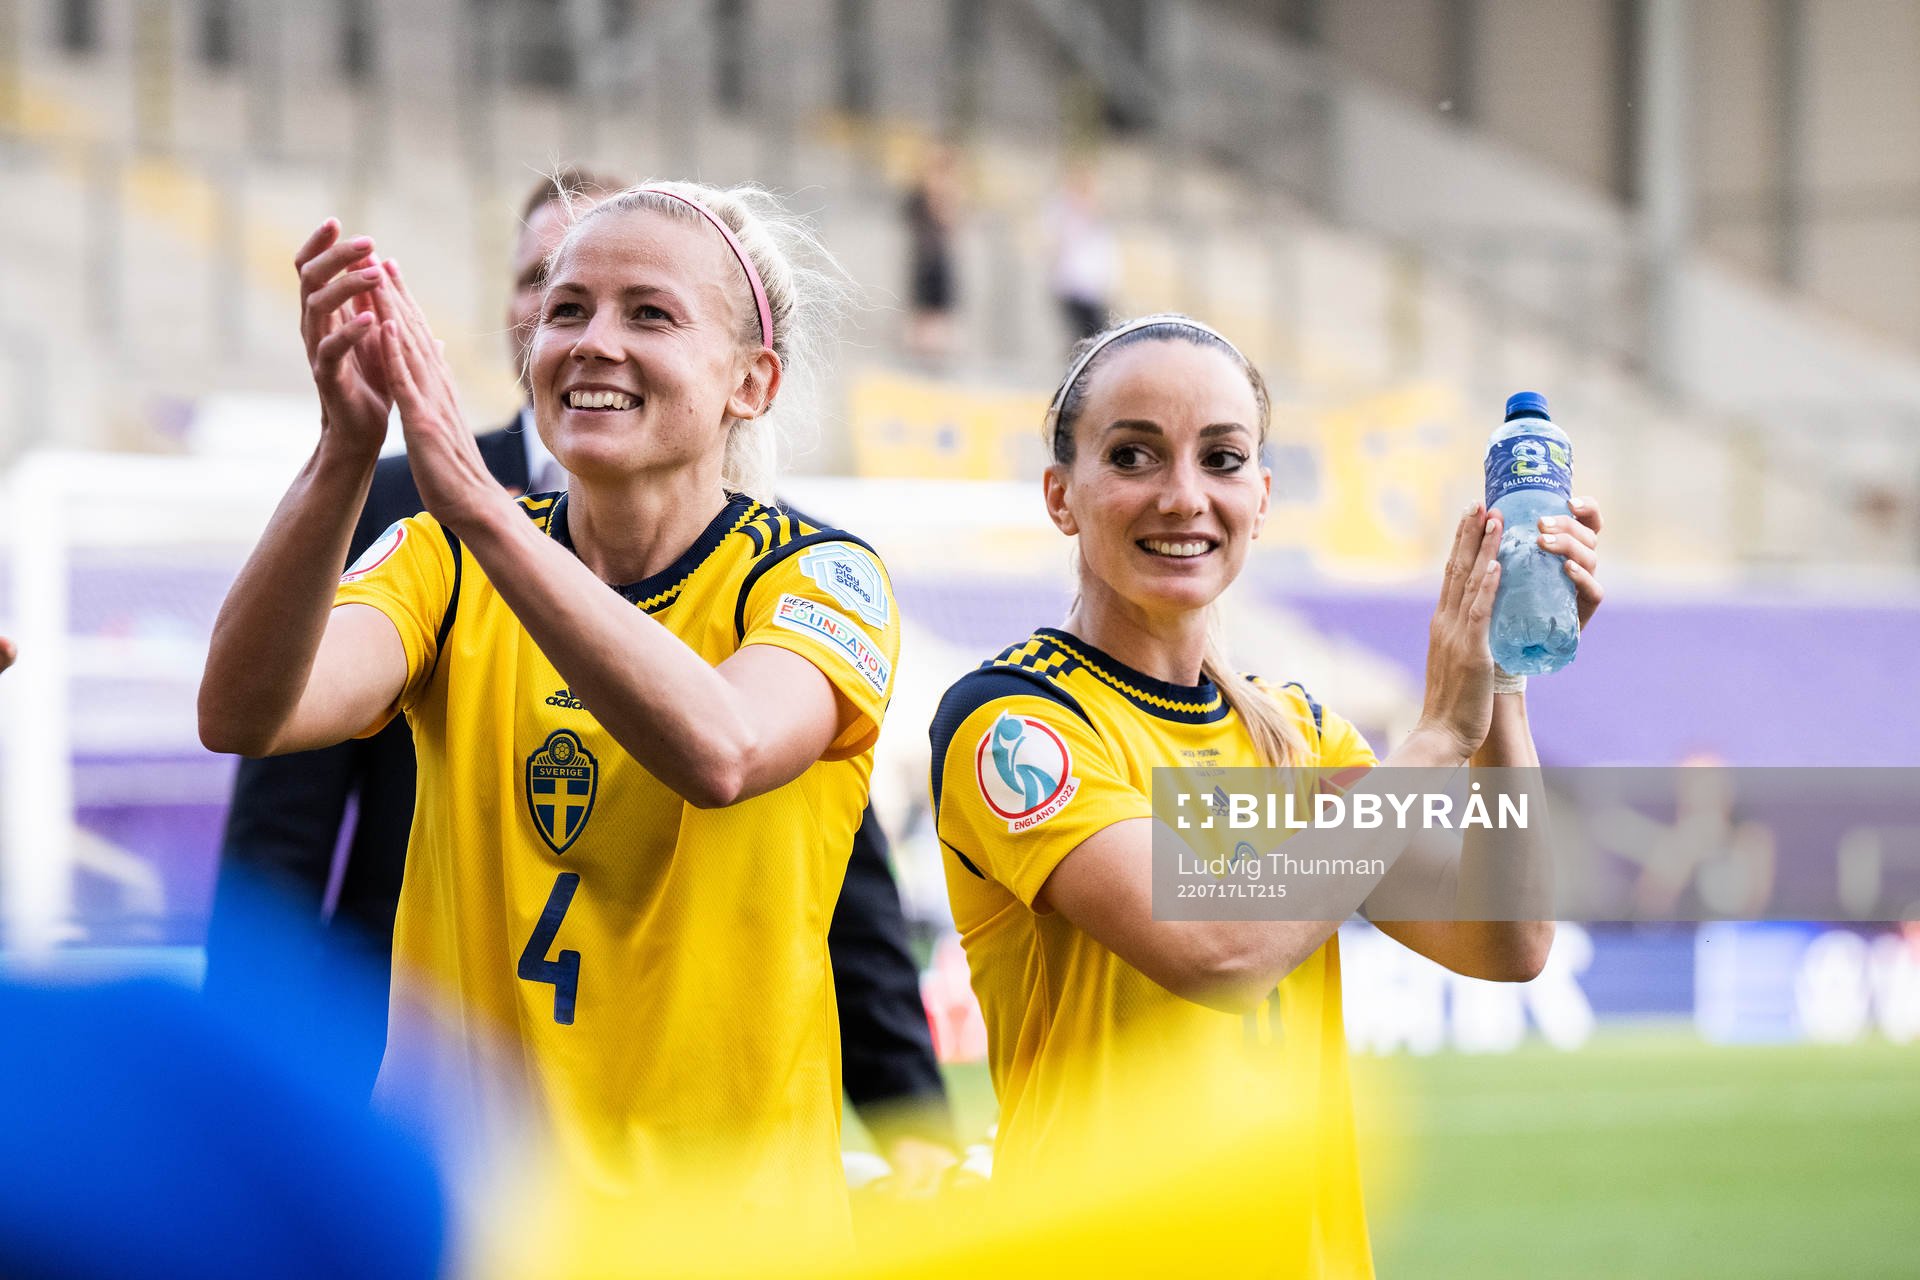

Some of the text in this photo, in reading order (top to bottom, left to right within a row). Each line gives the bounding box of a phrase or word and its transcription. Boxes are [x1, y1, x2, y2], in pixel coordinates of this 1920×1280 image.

[1502, 476, 1561, 490] BALLYGOWAN
[833, 560, 852, 573] We
[834, 567, 860, 586] play
[783, 595, 815, 611] UEFA
[855, 660, 883, 692] for children
[539, 767, 583, 777] SVERIGE
[1014, 784, 1075, 831] ENGLAND 2022
[517, 872, 581, 1026] 4
